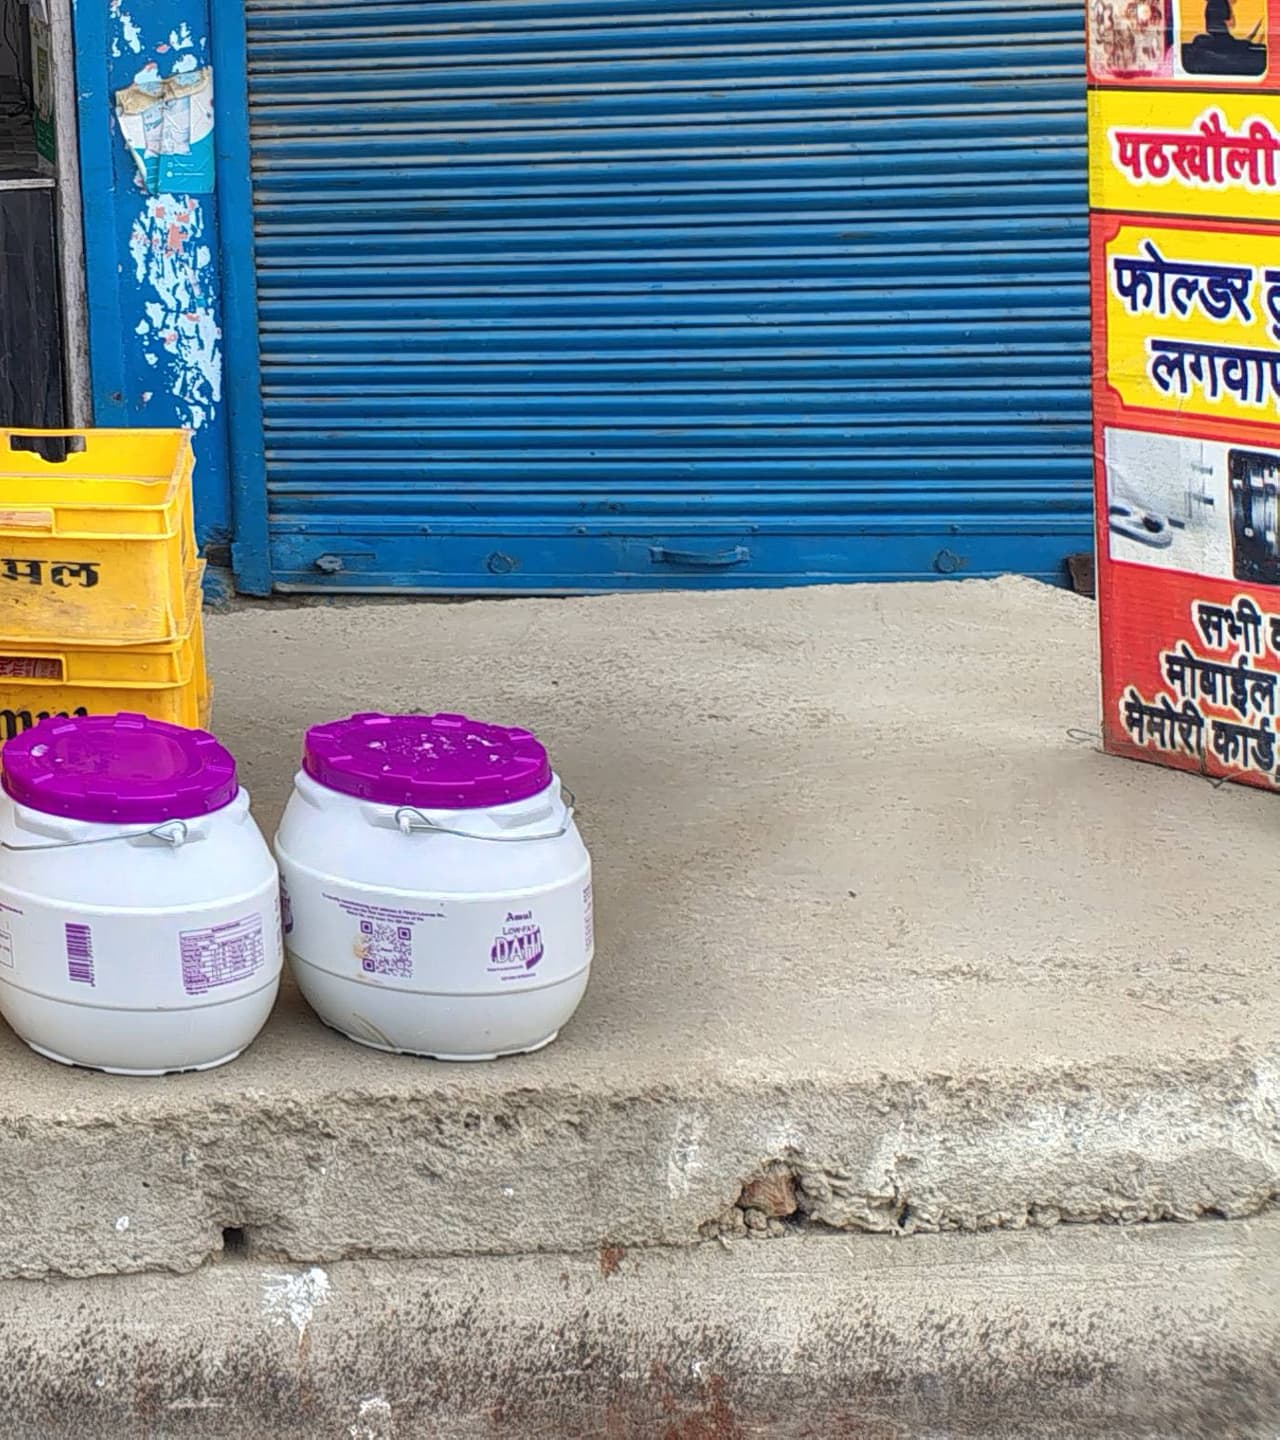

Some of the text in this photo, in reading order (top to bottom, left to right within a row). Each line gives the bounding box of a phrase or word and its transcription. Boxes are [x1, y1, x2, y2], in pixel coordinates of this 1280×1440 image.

[1113, 240, 1253, 323] फोल्डर
[1197, 596, 1262, 656] सभी
[1164, 643, 1278, 718] मोबाईल
[1123, 689, 1205, 757] मेमोरी
[493, 927, 543, 965] DAHI
[505, 910, 532, 923] Amul
